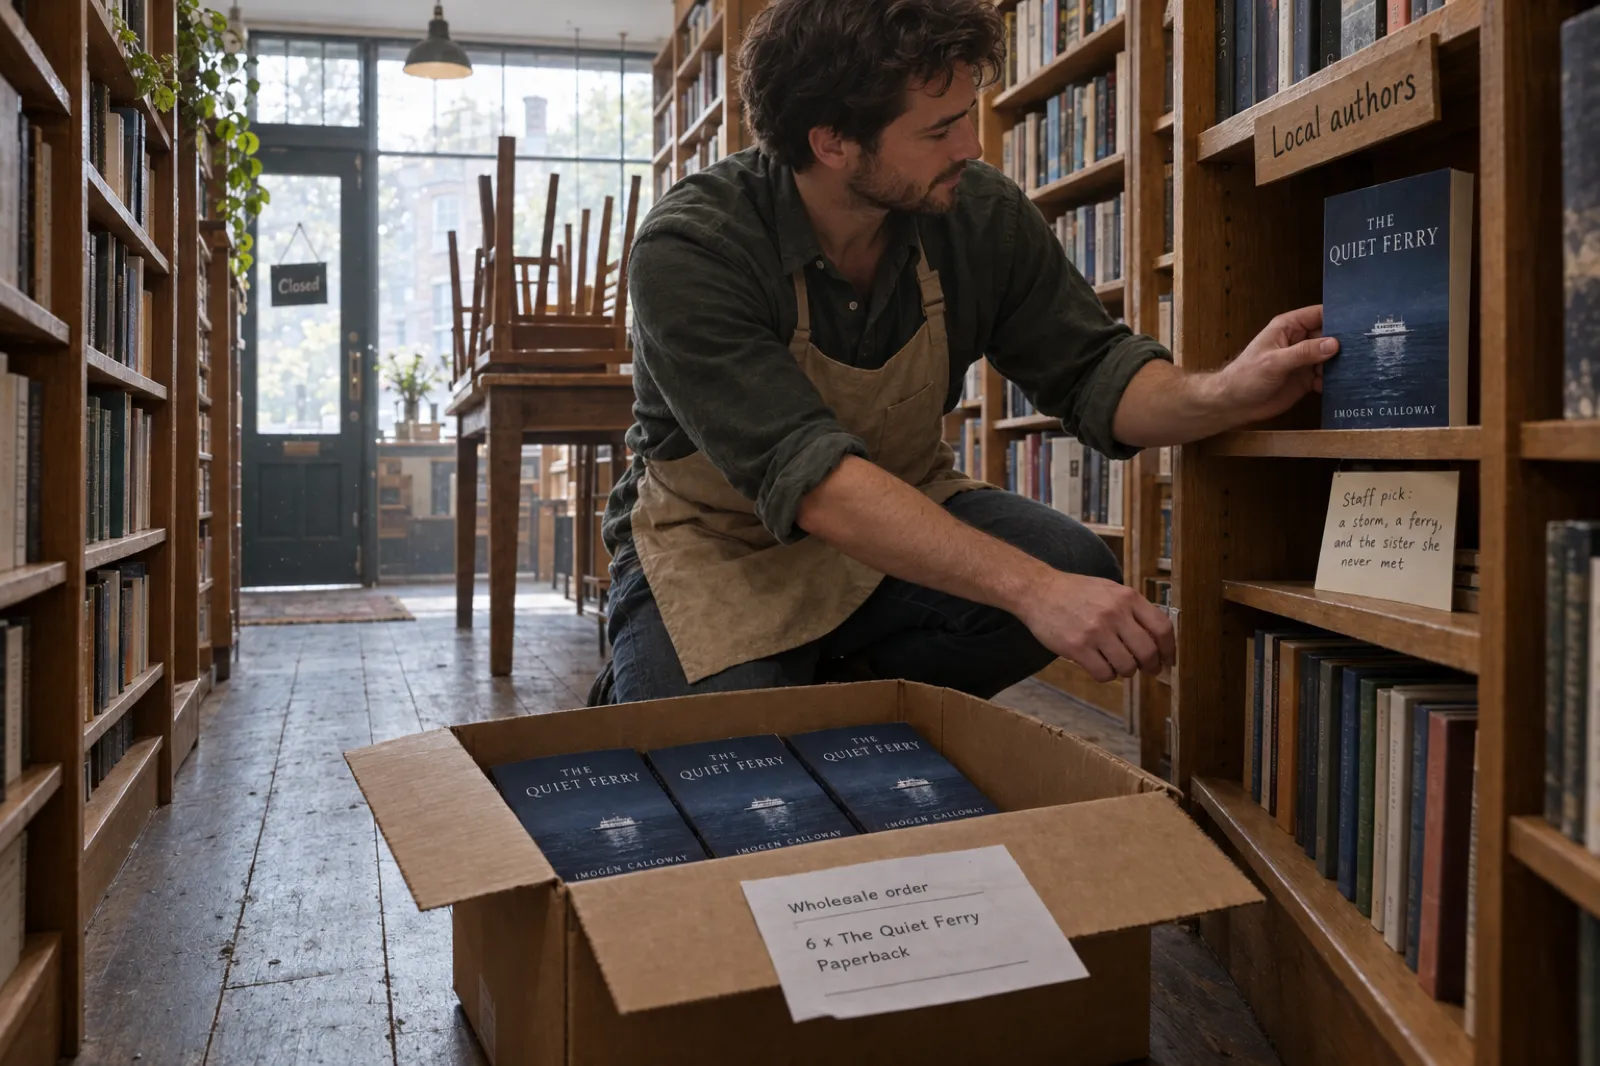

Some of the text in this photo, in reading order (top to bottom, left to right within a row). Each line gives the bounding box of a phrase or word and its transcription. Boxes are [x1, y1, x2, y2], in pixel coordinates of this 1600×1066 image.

[1272, 74, 1417, 159] Local authors
[1366, 213, 1395, 231] THE
[1329, 226, 1439, 266] QUIET FERRY
[278, 275, 320, 295] Closed
[1334, 404, 1436, 418] IMOGEN CALLOWAY
[1342, 486, 1413, 507] Staff pick:
[1338, 510, 1443, 535] a storm, a ferry,
[1333, 535, 1440, 552] and the sister she
[1341, 558, 1405, 570] never met
[708, 751, 739, 762] THE
[823, 740, 921, 763] QUIET FERRY
[559, 765, 593, 778] THE
[679, 756, 785, 782] QUIET FERRY
[525, 771, 641, 799] QUIET FERRY
[735, 829, 843, 856] IMOGEN CALLOWAY
[574, 853, 689, 881] IMOGEN CALLOWAY
[787, 882, 929, 914] Wholesale order
[805, 912, 981, 951] 6 x The Quiet Ferry
[816, 945, 911, 972] Paperback
